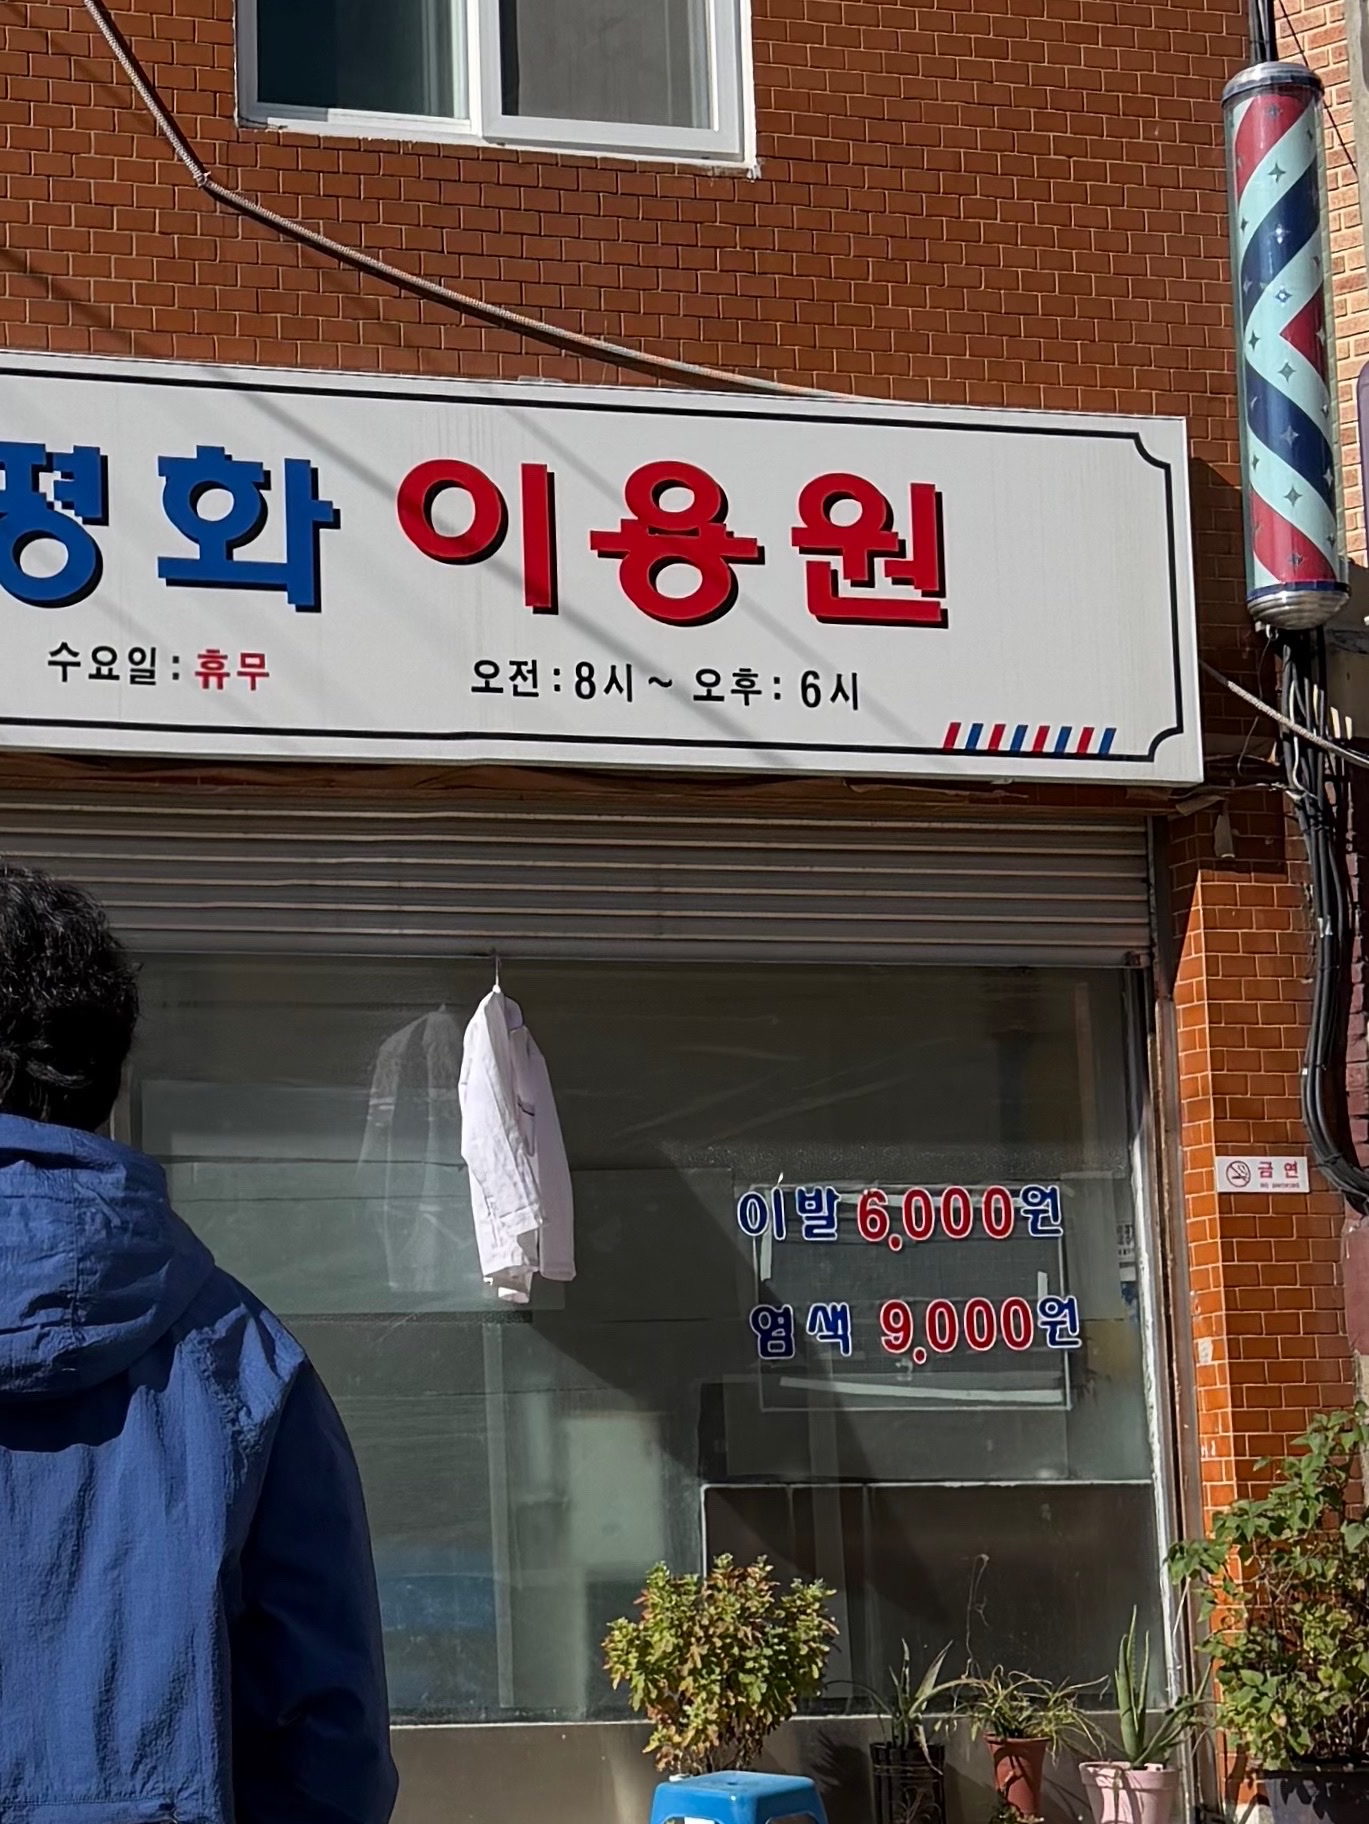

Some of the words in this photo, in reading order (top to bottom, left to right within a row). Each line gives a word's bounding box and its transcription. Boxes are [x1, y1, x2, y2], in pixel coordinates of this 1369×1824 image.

[396, 458, 949, 628] 이용원
[194, 648, 270, 690] 휴무
[737, 1185, 841, 1242] 이발
[749, 1301, 852, 1361] 염색
